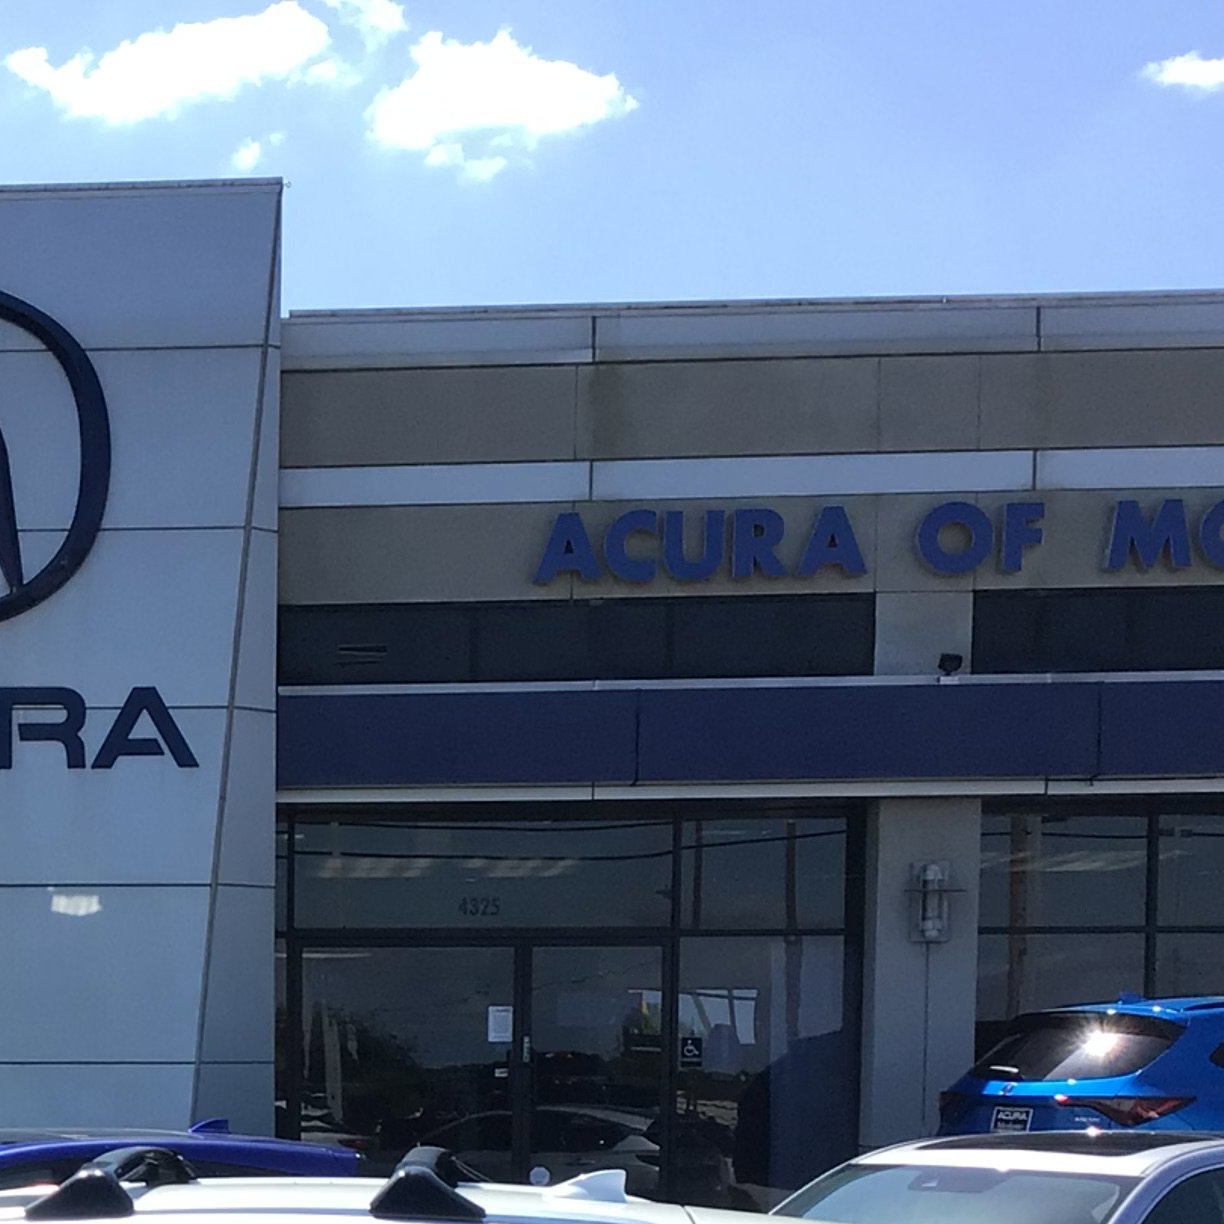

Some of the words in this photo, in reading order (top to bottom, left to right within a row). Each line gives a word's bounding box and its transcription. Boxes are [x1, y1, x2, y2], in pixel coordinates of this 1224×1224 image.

[532, 505, 868, 585] ACURA
[916, 500, 1045, 574] OF
[458, 897, 501, 916] 4325
[997, 1111, 1028, 1120] ACURA
